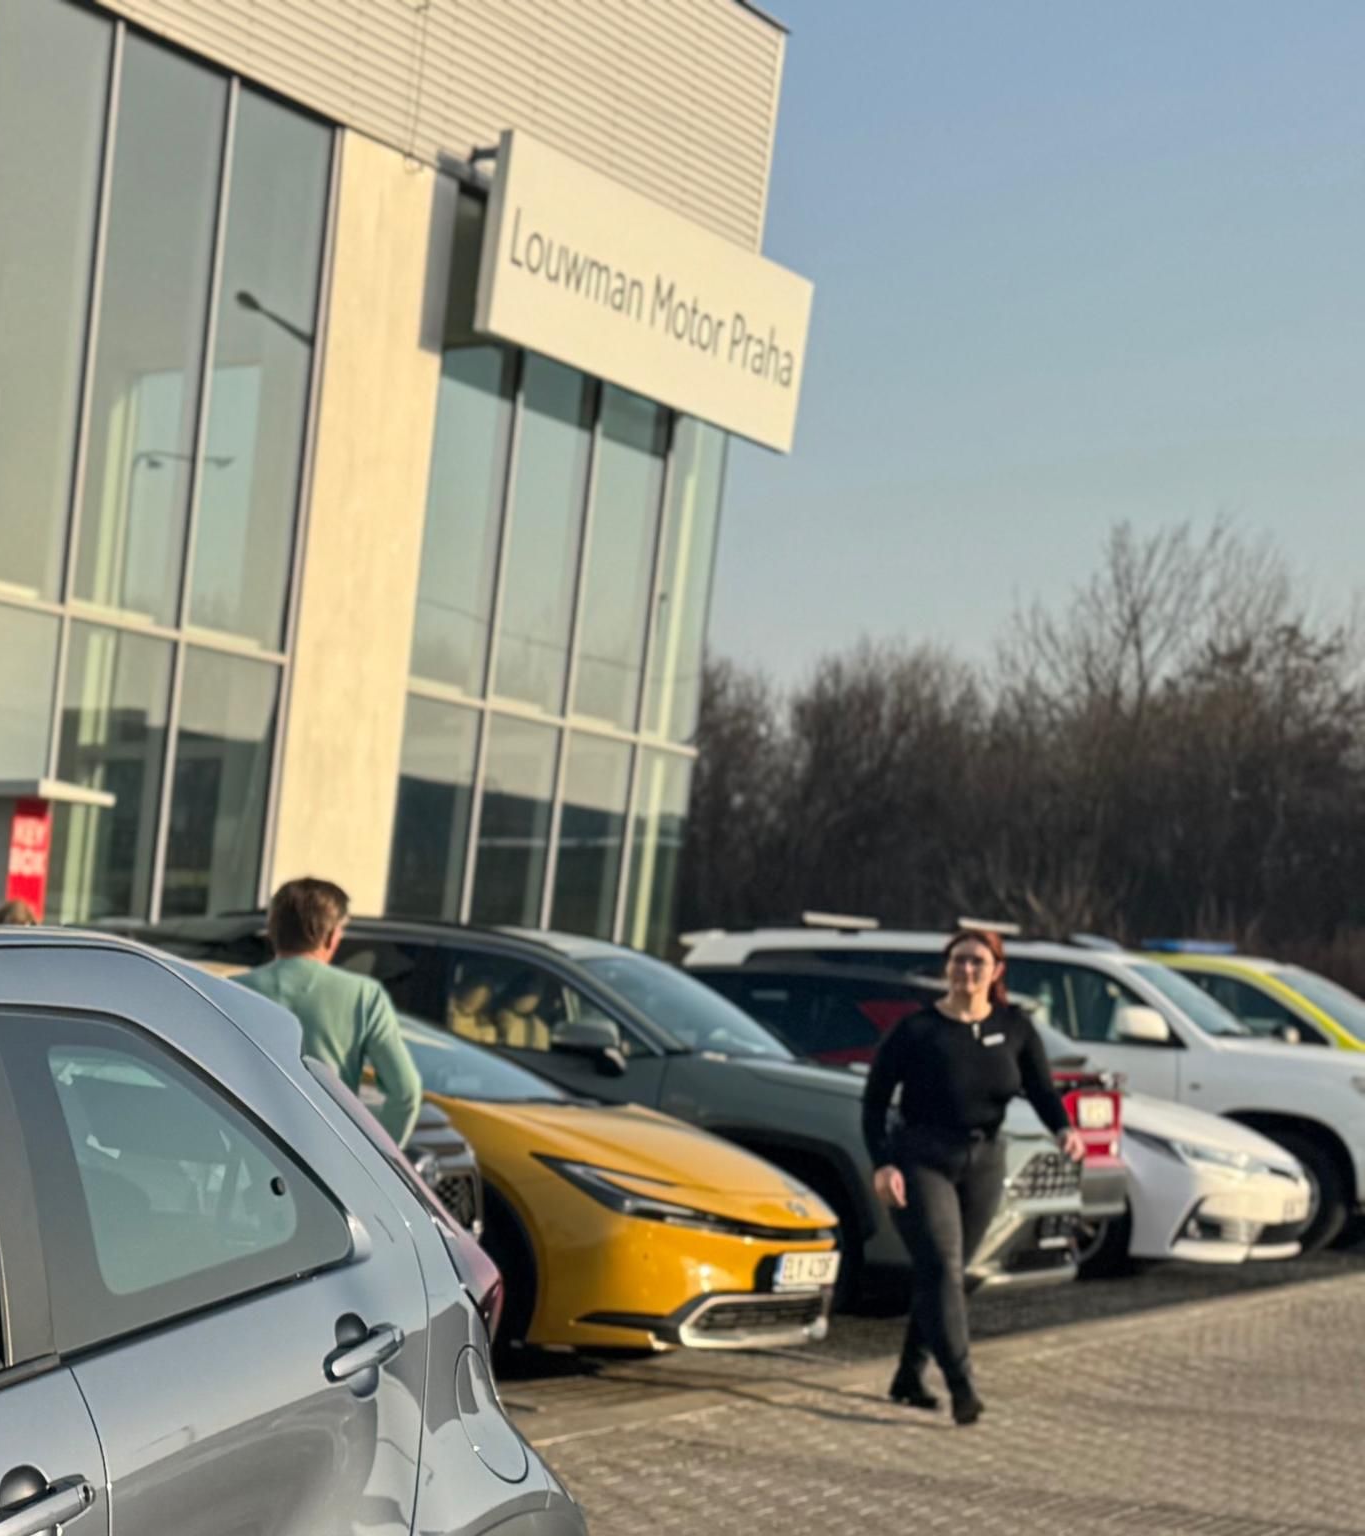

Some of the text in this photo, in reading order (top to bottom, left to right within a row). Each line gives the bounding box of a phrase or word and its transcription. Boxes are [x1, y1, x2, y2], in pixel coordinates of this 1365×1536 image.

[509, 208, 794, 387] Louwman Motor Praha
